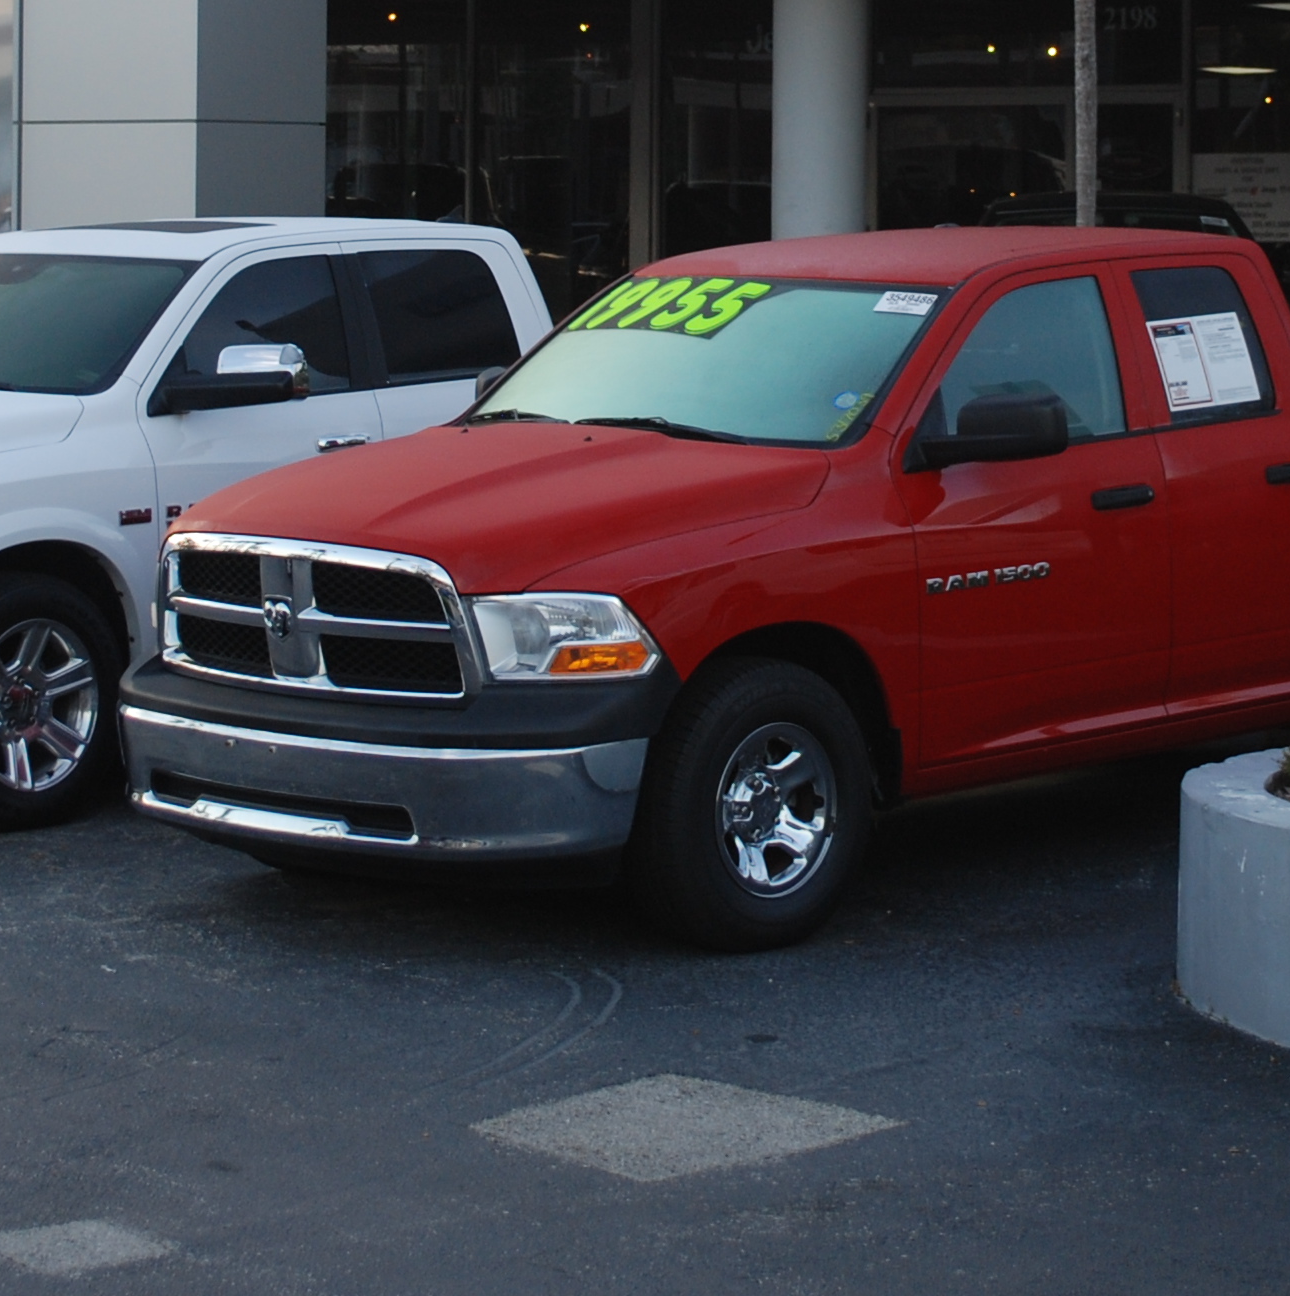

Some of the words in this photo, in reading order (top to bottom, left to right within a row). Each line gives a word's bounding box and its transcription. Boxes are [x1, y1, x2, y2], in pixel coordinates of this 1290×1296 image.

[1103, 5, 1157, 30] 2198
[567, 277, 772, 335] 19955
[926, 570, 990, 594] RAM
[993, 560, 1051, 585] 1500
